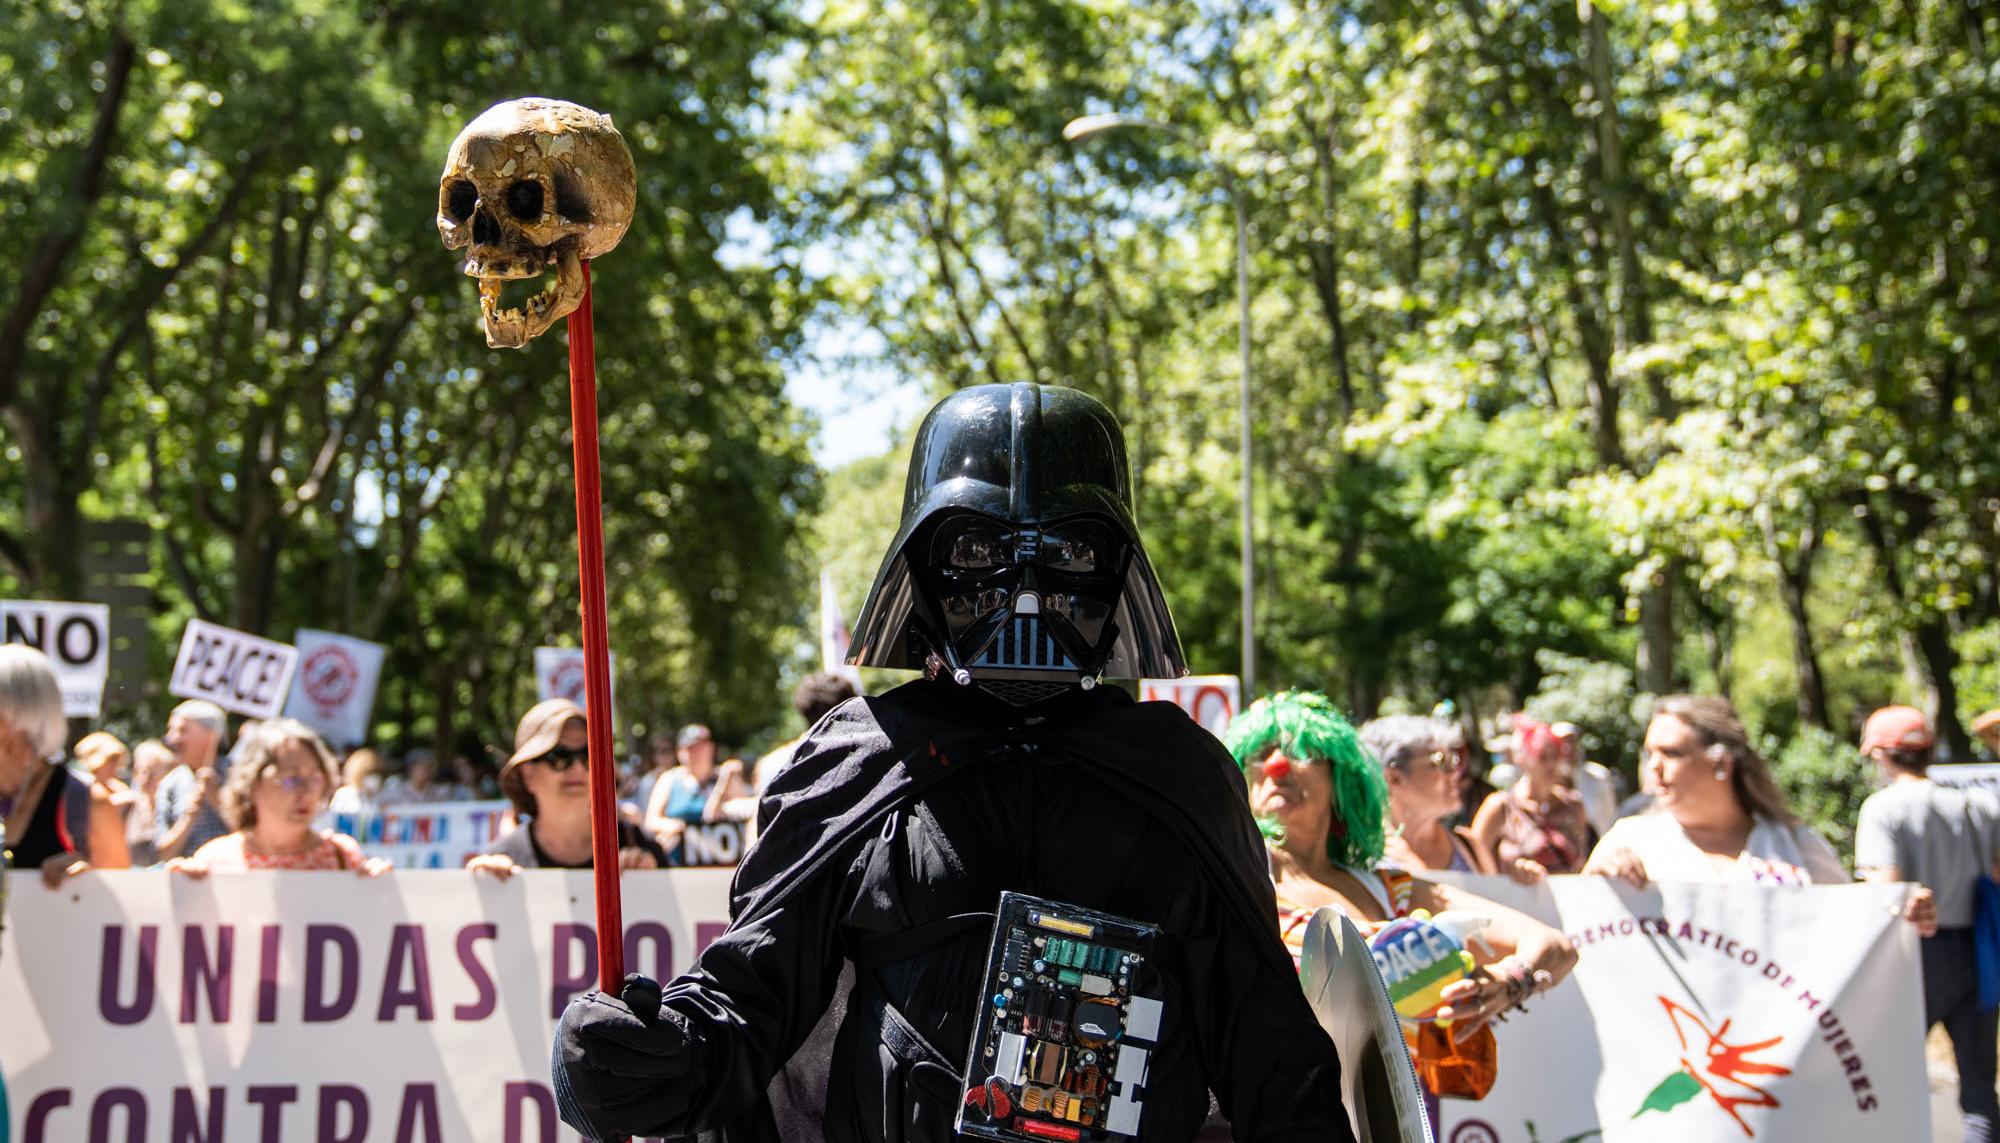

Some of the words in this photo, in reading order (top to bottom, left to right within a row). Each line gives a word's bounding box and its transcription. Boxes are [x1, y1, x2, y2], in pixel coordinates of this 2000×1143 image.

[5, 613, 99, 666] NO
[98, 922, 497, 1025] UNIDAS
[1373, 924, 1451, 986] PACE
[1798, 989, 1879, 1113] MUJERES
